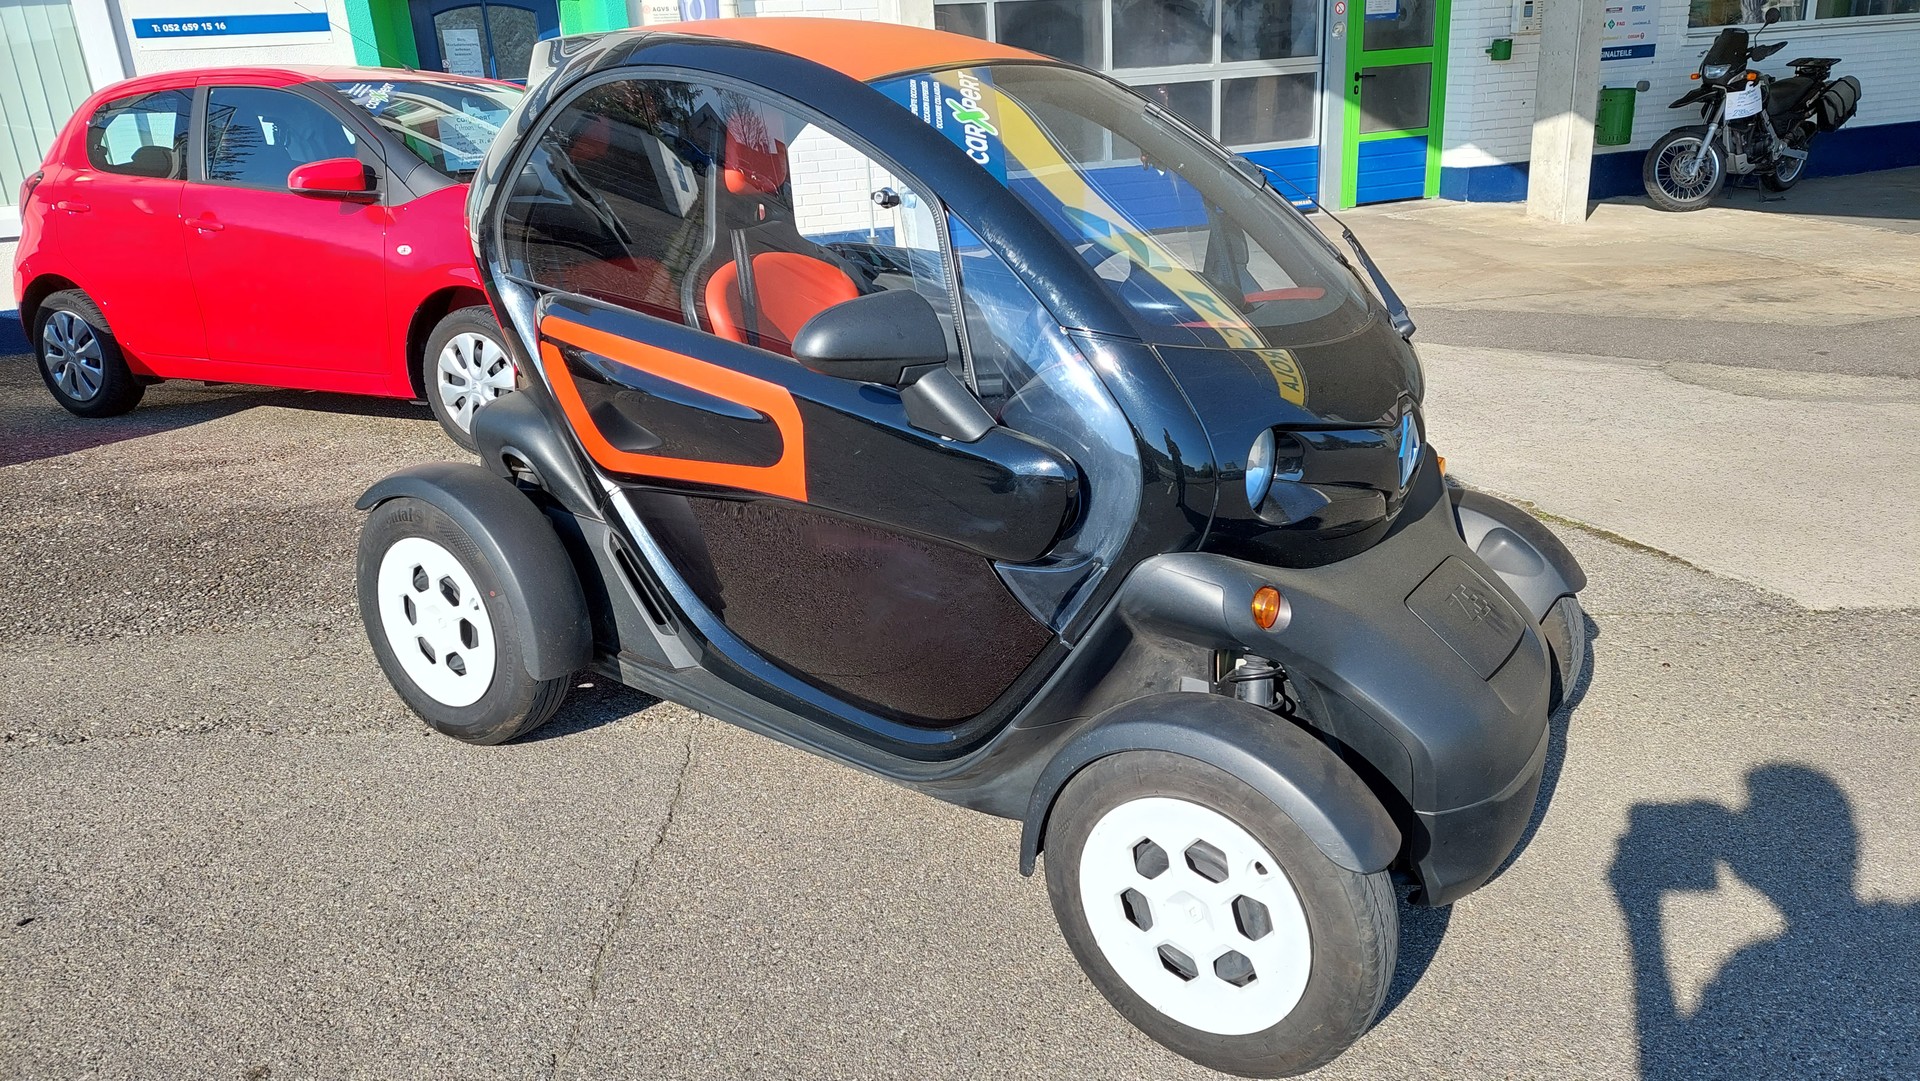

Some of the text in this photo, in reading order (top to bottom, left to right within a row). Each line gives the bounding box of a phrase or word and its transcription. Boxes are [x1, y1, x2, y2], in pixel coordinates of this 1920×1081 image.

[152, 22, 226, 32] T: 052 659 15 16
